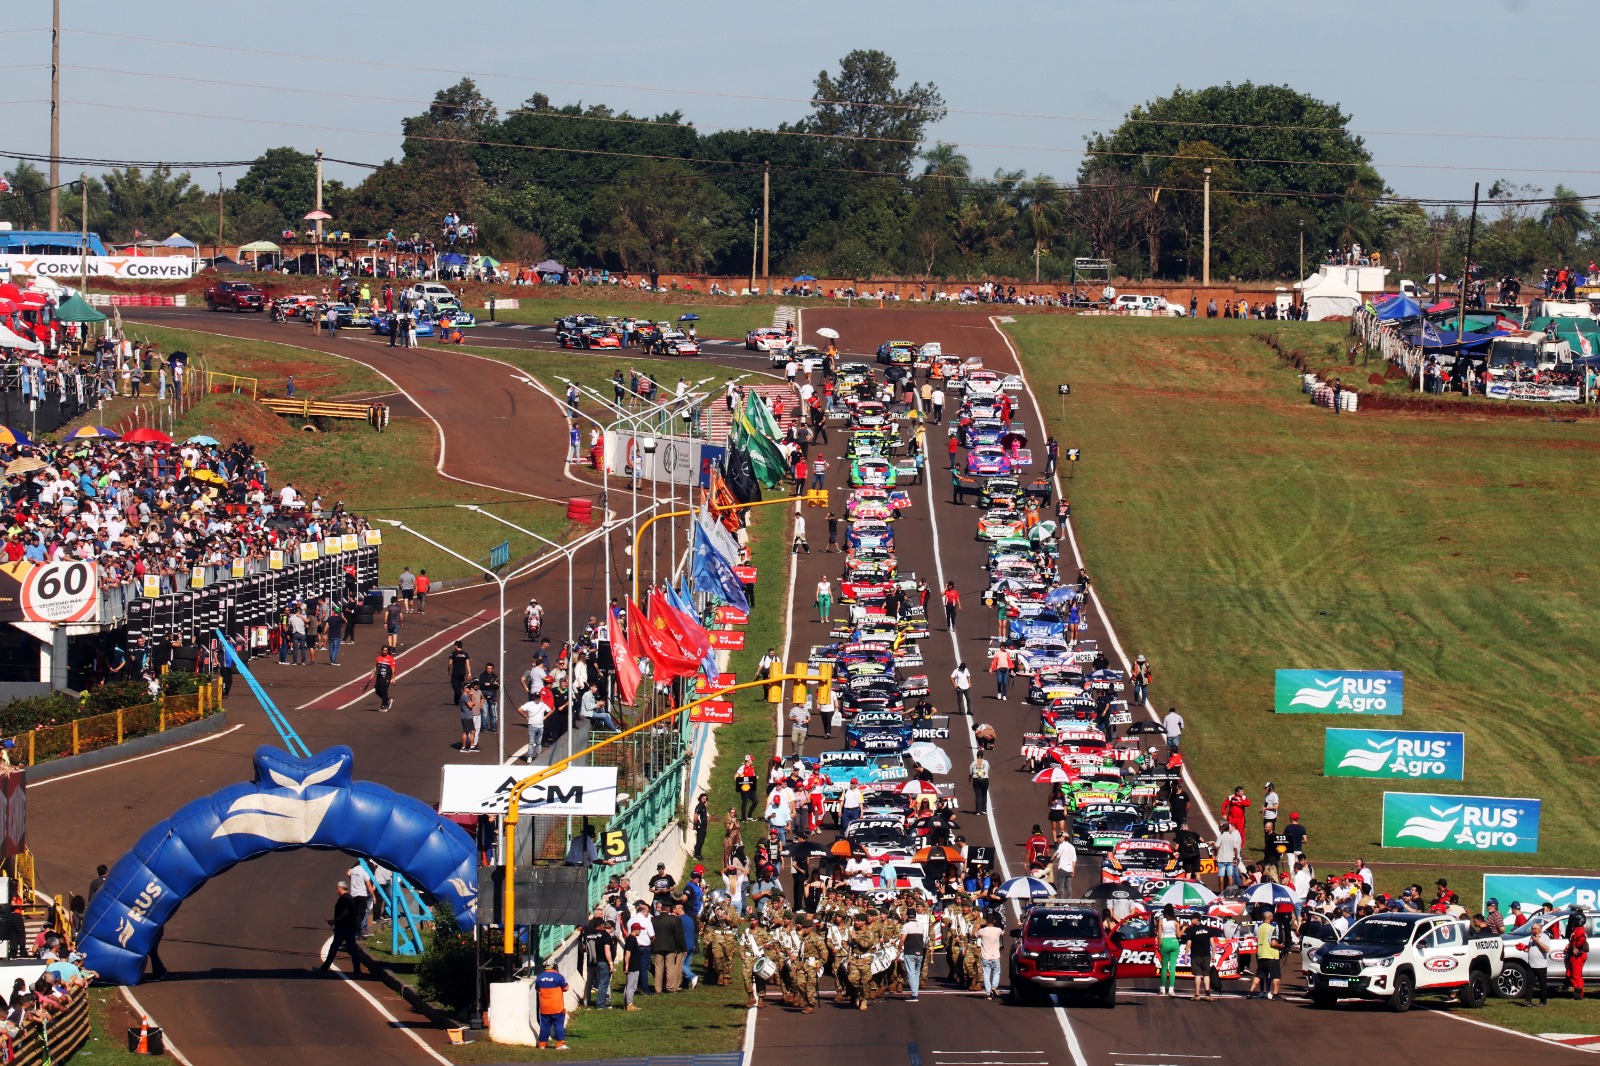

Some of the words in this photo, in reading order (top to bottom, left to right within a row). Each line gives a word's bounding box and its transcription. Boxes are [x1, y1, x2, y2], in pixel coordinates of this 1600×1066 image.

[36, 262, 99, 275] CORVN
[126, 264, 189, 276] CORVEN
[37, 563, 88, 600] 60
[1335, 694, 1387, 712] Agro
[820, 753, 866, 761] LIMART
[1389, 757, 1446, 777] Agro
[494, 776, 584, 804] ACM
[606, 830, 626, 856] 5
[1130, 841, 1171, 851] SCIENZA
[1453, 827, 1518, 849] Agro
[1475, 940, 1499, 950] MEDICO
[1118, 949, 1154, 965] PACE
